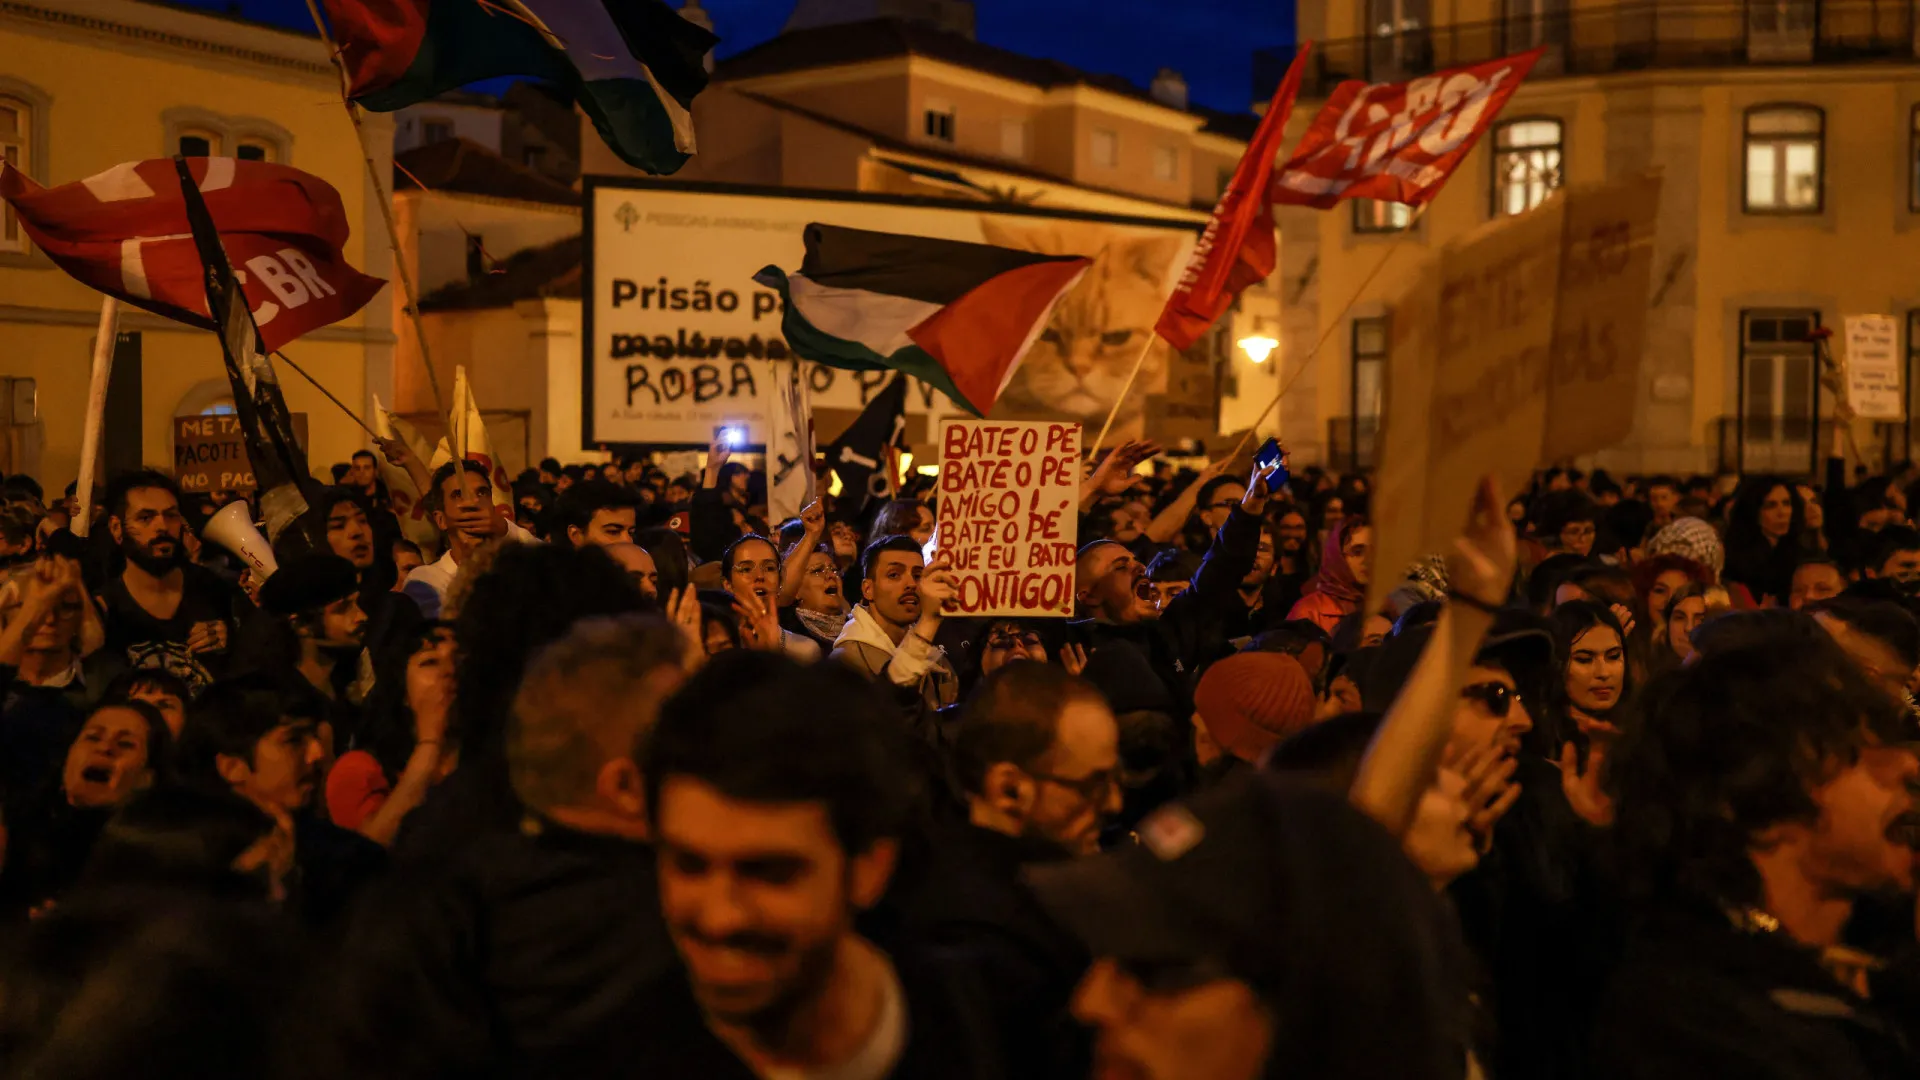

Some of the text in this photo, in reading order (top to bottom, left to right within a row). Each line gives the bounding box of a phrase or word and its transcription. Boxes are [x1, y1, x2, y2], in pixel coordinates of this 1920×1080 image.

[611, 276, 739, 313] Prisão
[182, 417, 241, 438] META
[944, 422, 1082, 459] BATE O PÉ
[181, 472, 258, 489] NO PAC
[942, 452, 1081, 492] BATE O PÉ
[939, 500, 1070, 549] BATE O PÉ
[936, 542, 1077, 571] QUE EU BATO
